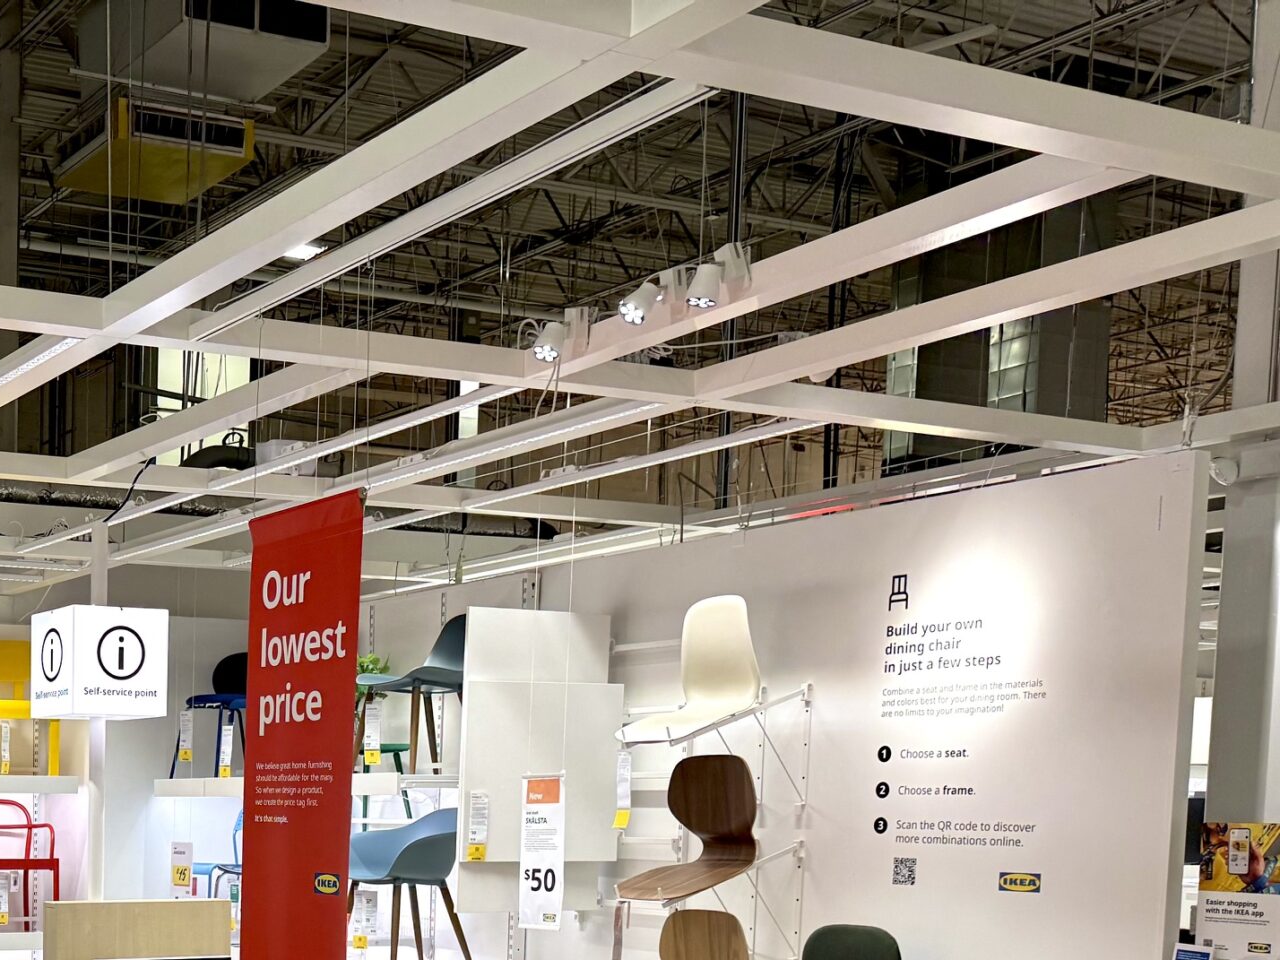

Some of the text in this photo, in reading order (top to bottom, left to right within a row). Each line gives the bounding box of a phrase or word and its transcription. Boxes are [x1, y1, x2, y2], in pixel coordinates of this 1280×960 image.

[262, 570, 311, 610] Our
[886, 619, 983, 638] Build your own
[260, 620, 347, 668] lowest
[885, 637, 961, 656] dining chair
[884, 654, 1001, 676] in just a few steps
[83, 687, 158, 699] Self-service point
[882, 678, 1043, 697] Combine a seat and frame in the materials
[881, 690, 1047, 707] and colors best for your dining room. There
[259, 682, 322, 736] price
[881, 704, 1004, 718] are no limits to your imagination!
[900, 748, 935, 759] Choose
[936, 750, 942, 758] a
[944, 748, 969, 759] seat.
[255, 762, 264, 770] We
[279, 762, 291, 771] great
[291, 761, 306, 769] home
[307, 760, 333, 771] furnishing
[277, 773, 300, 782] affordable
[301, 773, 309, 781] for
[310, 773, 319, 782] the
[255, 786, 262, 794] So
[281, 786, 297, 795] design
[301, 786, 324, 795] product,
[528, 792, 544, 801] New
[898, 785, 933, 796] Choose
[934, 787, 940, 796] a
[942, 785, 976, 796] frame.
[284, 799, 295, 807] price
[296, 799, 305, 808] tag
[254, 815, 263, 823] It's
[263, 814, 273, 823] that
[896, 819, 918, 830] Scan
[919, 820, 935, 831] the
[937, 820, 952, 833] QR
[953, 820, 978, 832] code
[980, 822, 991, 832] to
[993, 821, 1037, 833] discover
[895, 834, 1024, 848] more combinations online.
[524, 868, 556, 893] $50
[1206, 898, 1258, 909] Easier shopping
[1221, 907, 1233, 915] the
[1234, 908, 1250, 916] IKEA
[1251, 910, 1265, 918] app
